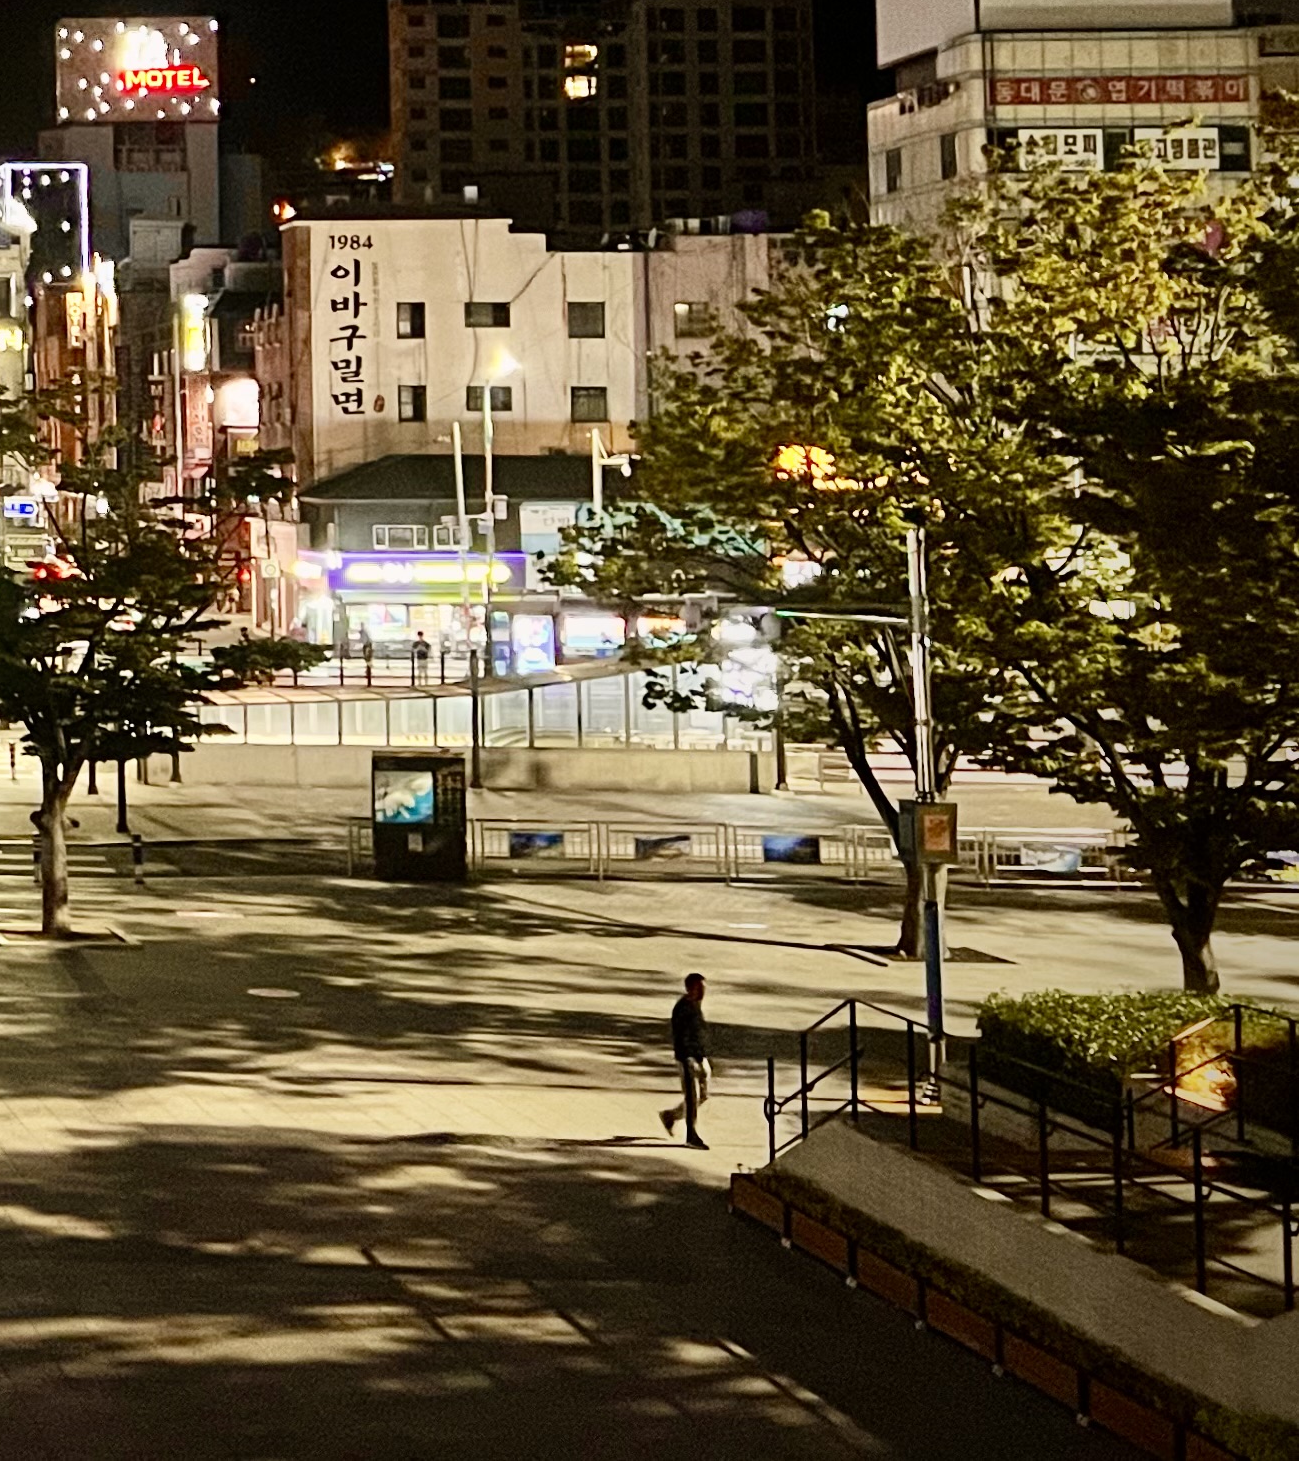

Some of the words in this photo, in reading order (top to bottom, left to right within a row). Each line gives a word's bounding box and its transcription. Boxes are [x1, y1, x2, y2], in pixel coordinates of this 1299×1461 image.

[124, 67, 210, 91] MOTEL
[995, 79, 1068, 103] 동대문
[329, 235, 373, 250] 1984
[330, 258, 368, 415] 이바구밀면
